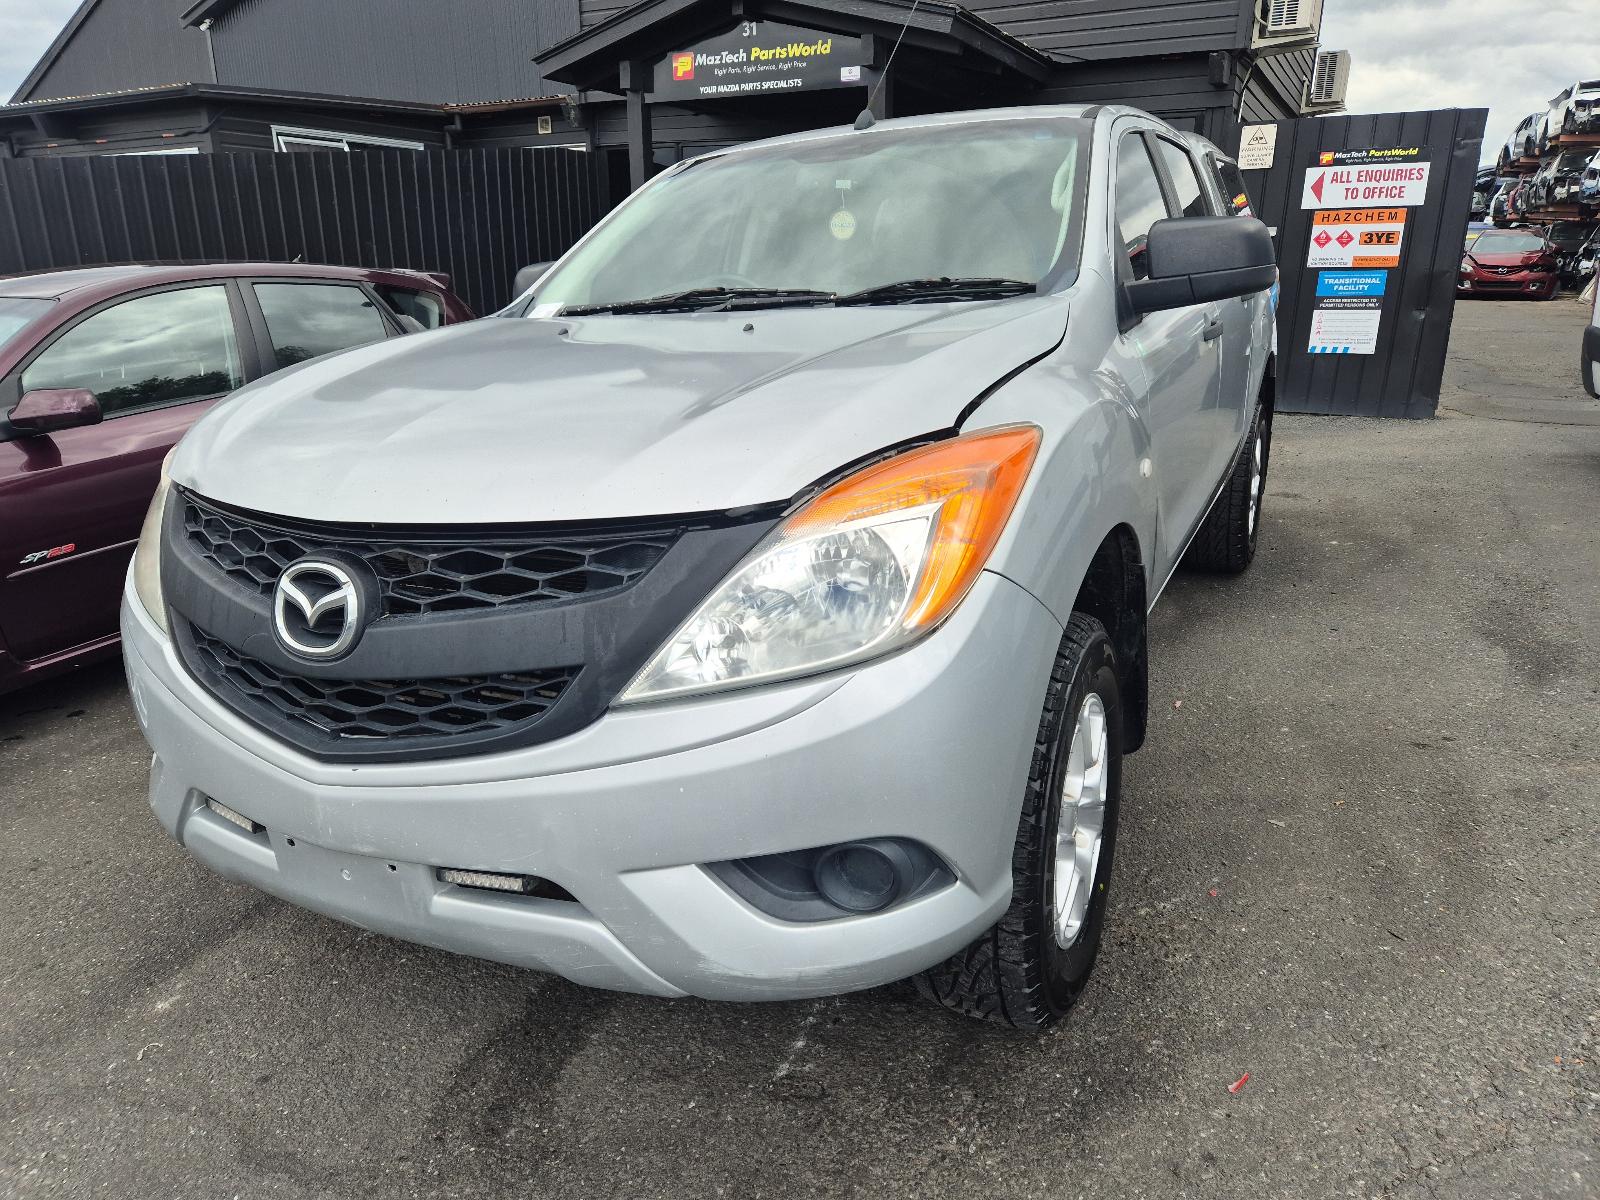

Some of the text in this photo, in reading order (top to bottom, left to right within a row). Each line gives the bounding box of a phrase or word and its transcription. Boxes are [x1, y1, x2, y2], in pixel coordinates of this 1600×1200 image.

[742, 22, 757, 36] 31
[695, 39, 832, 66] MazTech PartsWorld
[700, 79, 803, 94] YOUR MAZDA PARTS SPECIALISTS
[1334, 147, 1419, 159] MazTech PartsWorld
[1331, 168, 1424, 184] ALL ENQUIRIES
[1344, 186, 1406, 200] TO OFFICE
[1321, 212, 1398, 223] HAZCHEM
[1364, 232, 1395, 244] 3YE
